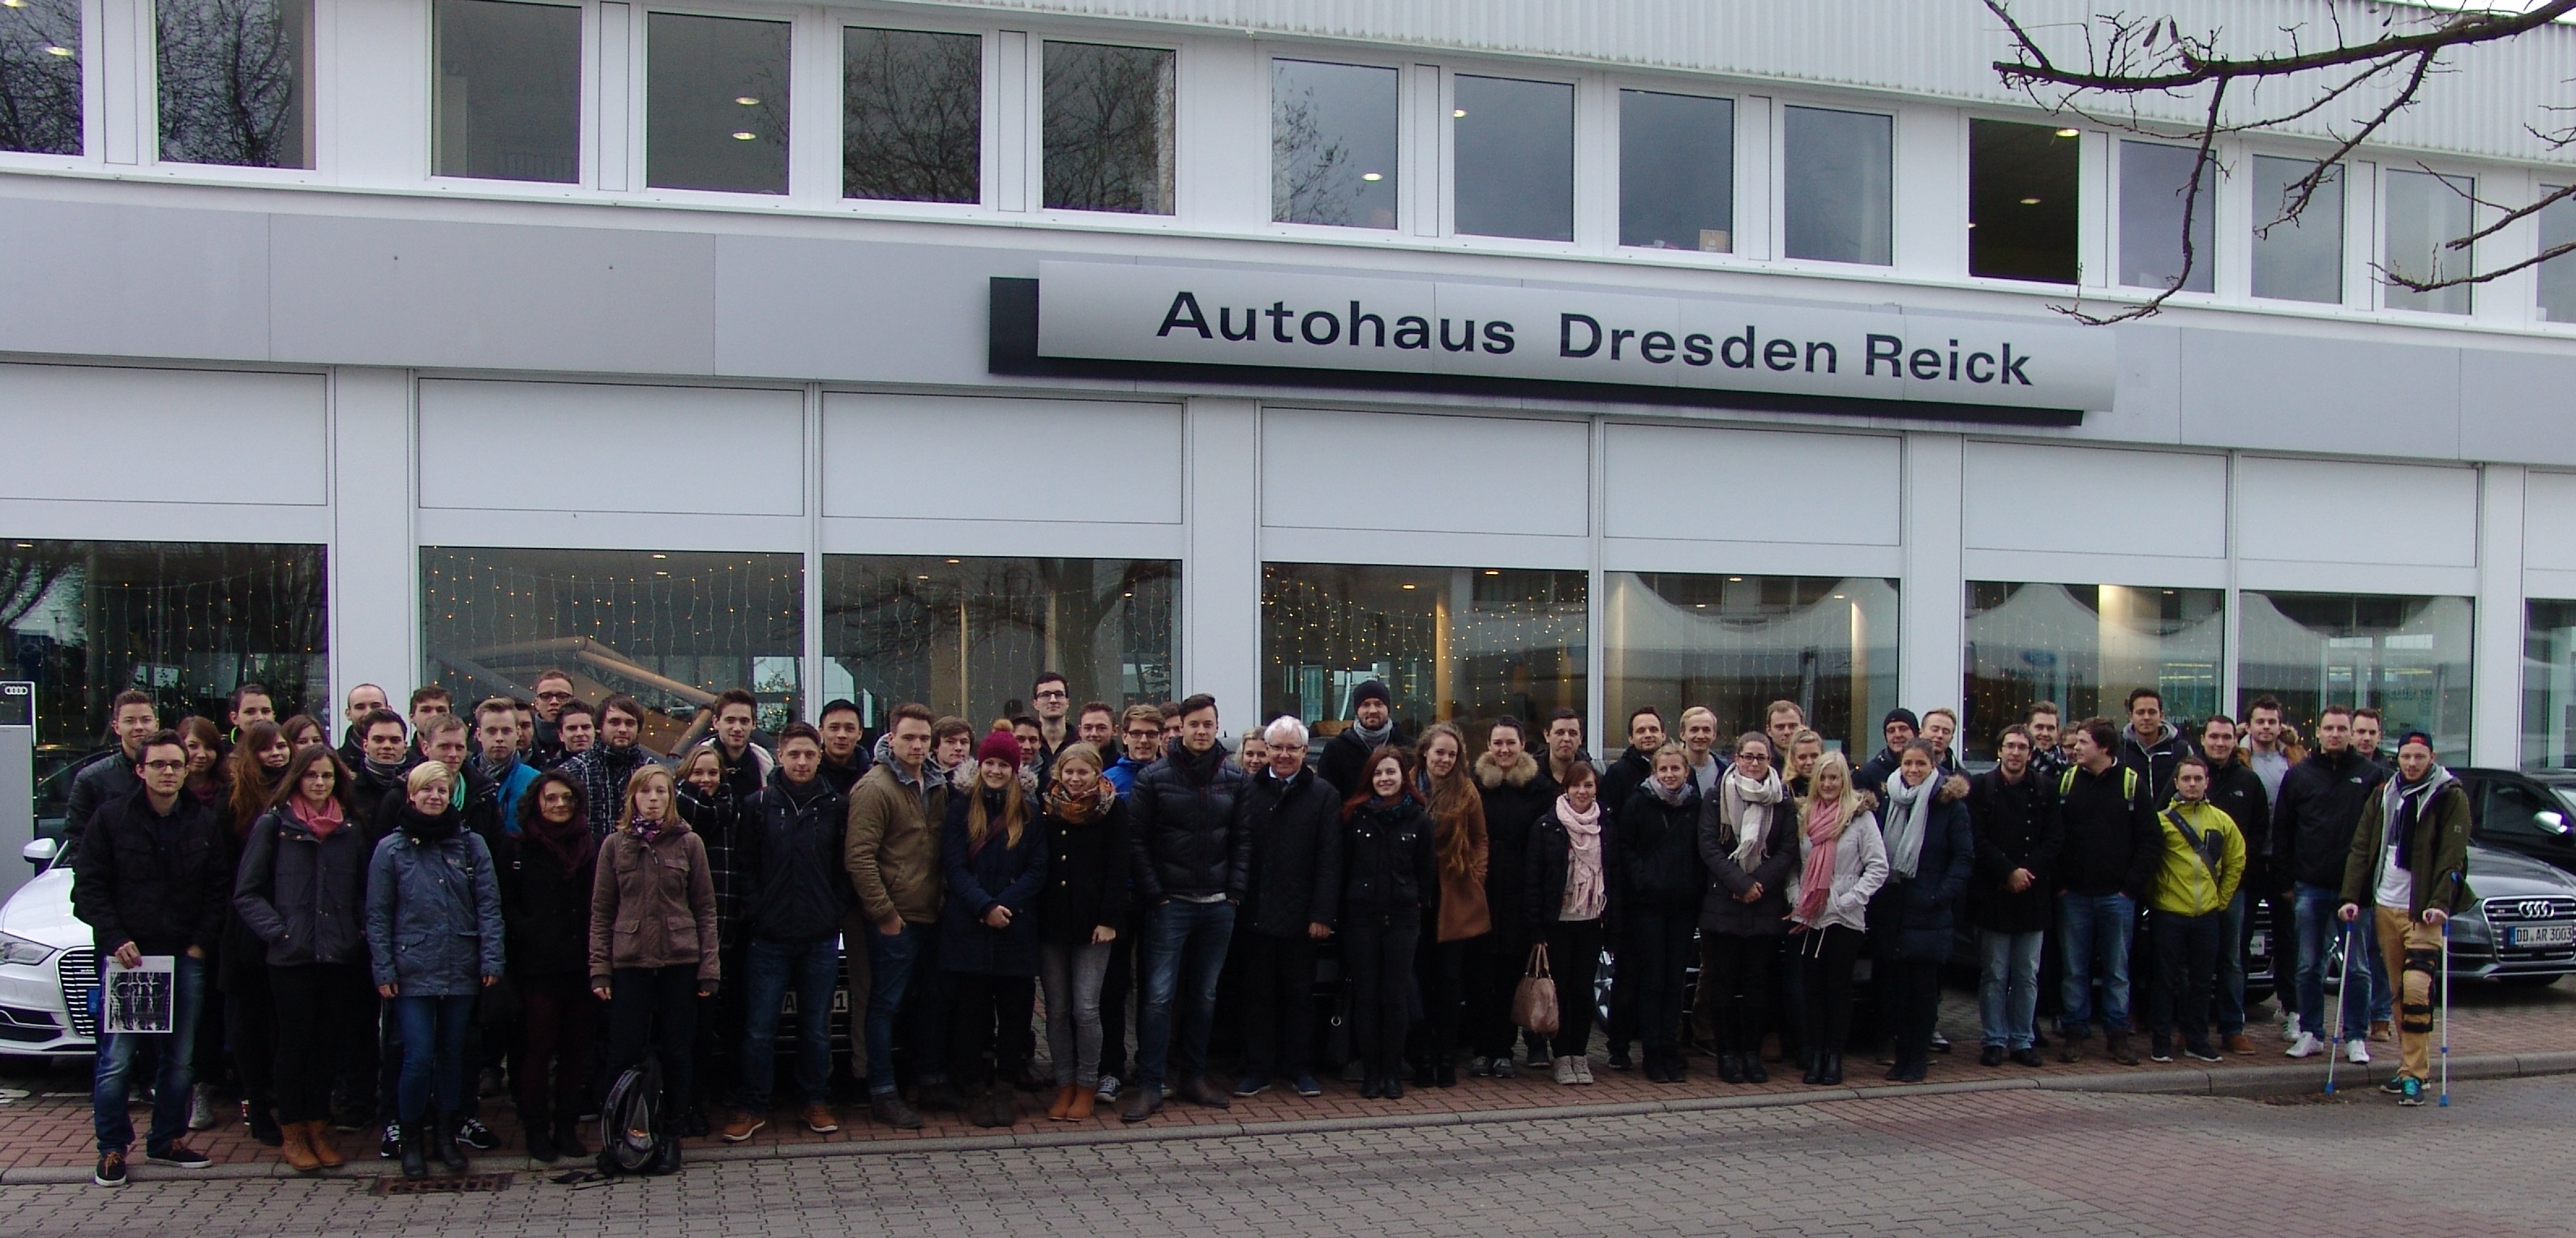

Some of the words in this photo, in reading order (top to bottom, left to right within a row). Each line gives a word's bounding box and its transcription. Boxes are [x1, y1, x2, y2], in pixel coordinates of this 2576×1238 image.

[1155, 291, 1515, 355] Autohaus
[1559, 312, 1838, 374] Dresden
[1865, 333, 2033, 386] Reick
[2516, 929, 2529, 942] DD
[2535, 928, 2548, 941] AR
[2549, 927, 2573, 940] 3003
